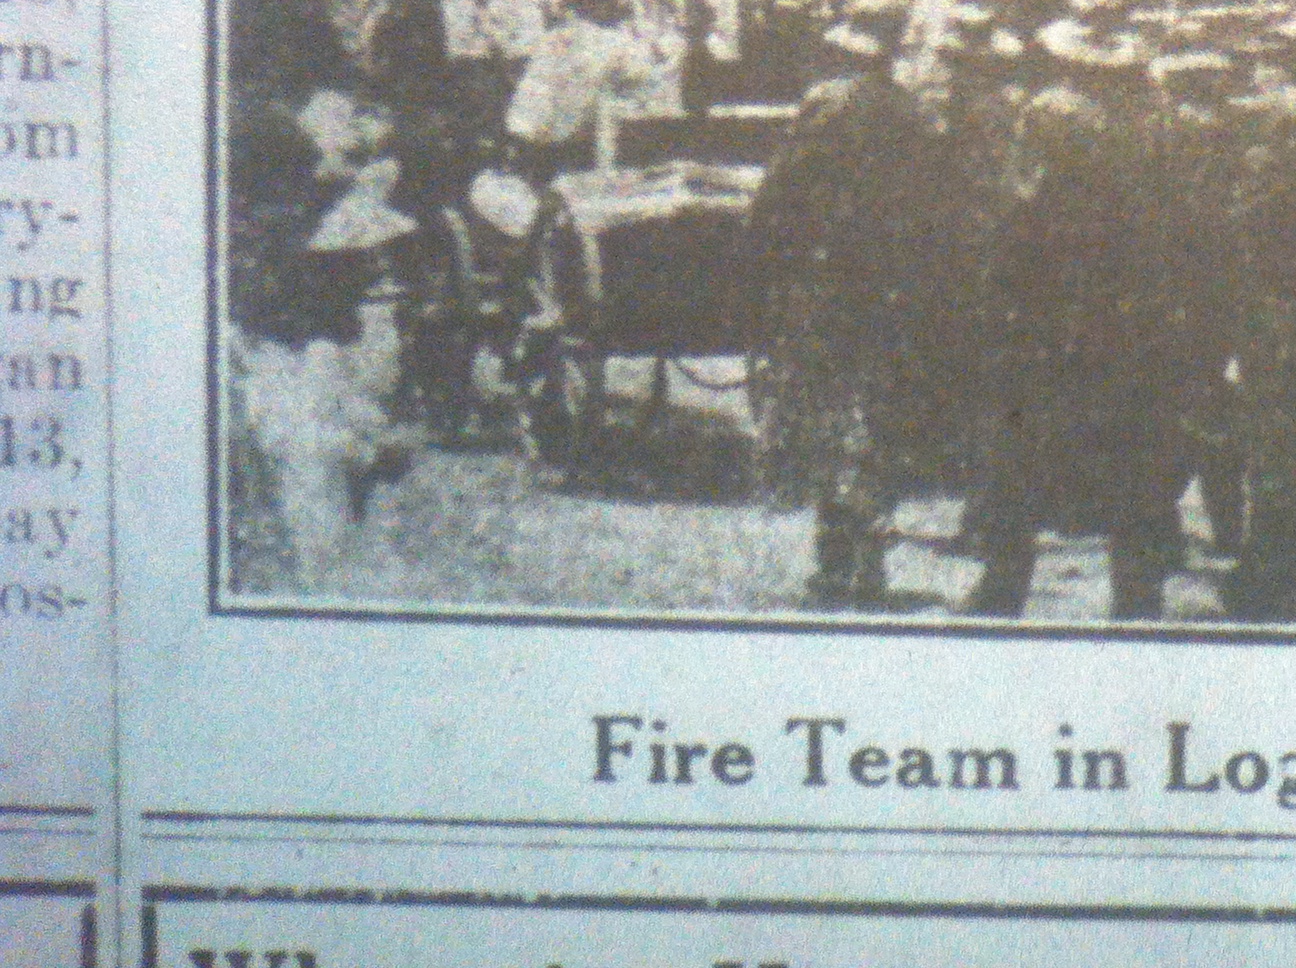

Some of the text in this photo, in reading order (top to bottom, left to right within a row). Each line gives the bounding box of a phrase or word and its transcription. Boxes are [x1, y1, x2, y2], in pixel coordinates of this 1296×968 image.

[6, 273, 85, 322] ng
[590, 713, 757, 788] Fire
[784, 716, 1021, 793] Team
[1053, 721, 1131, 794] in
